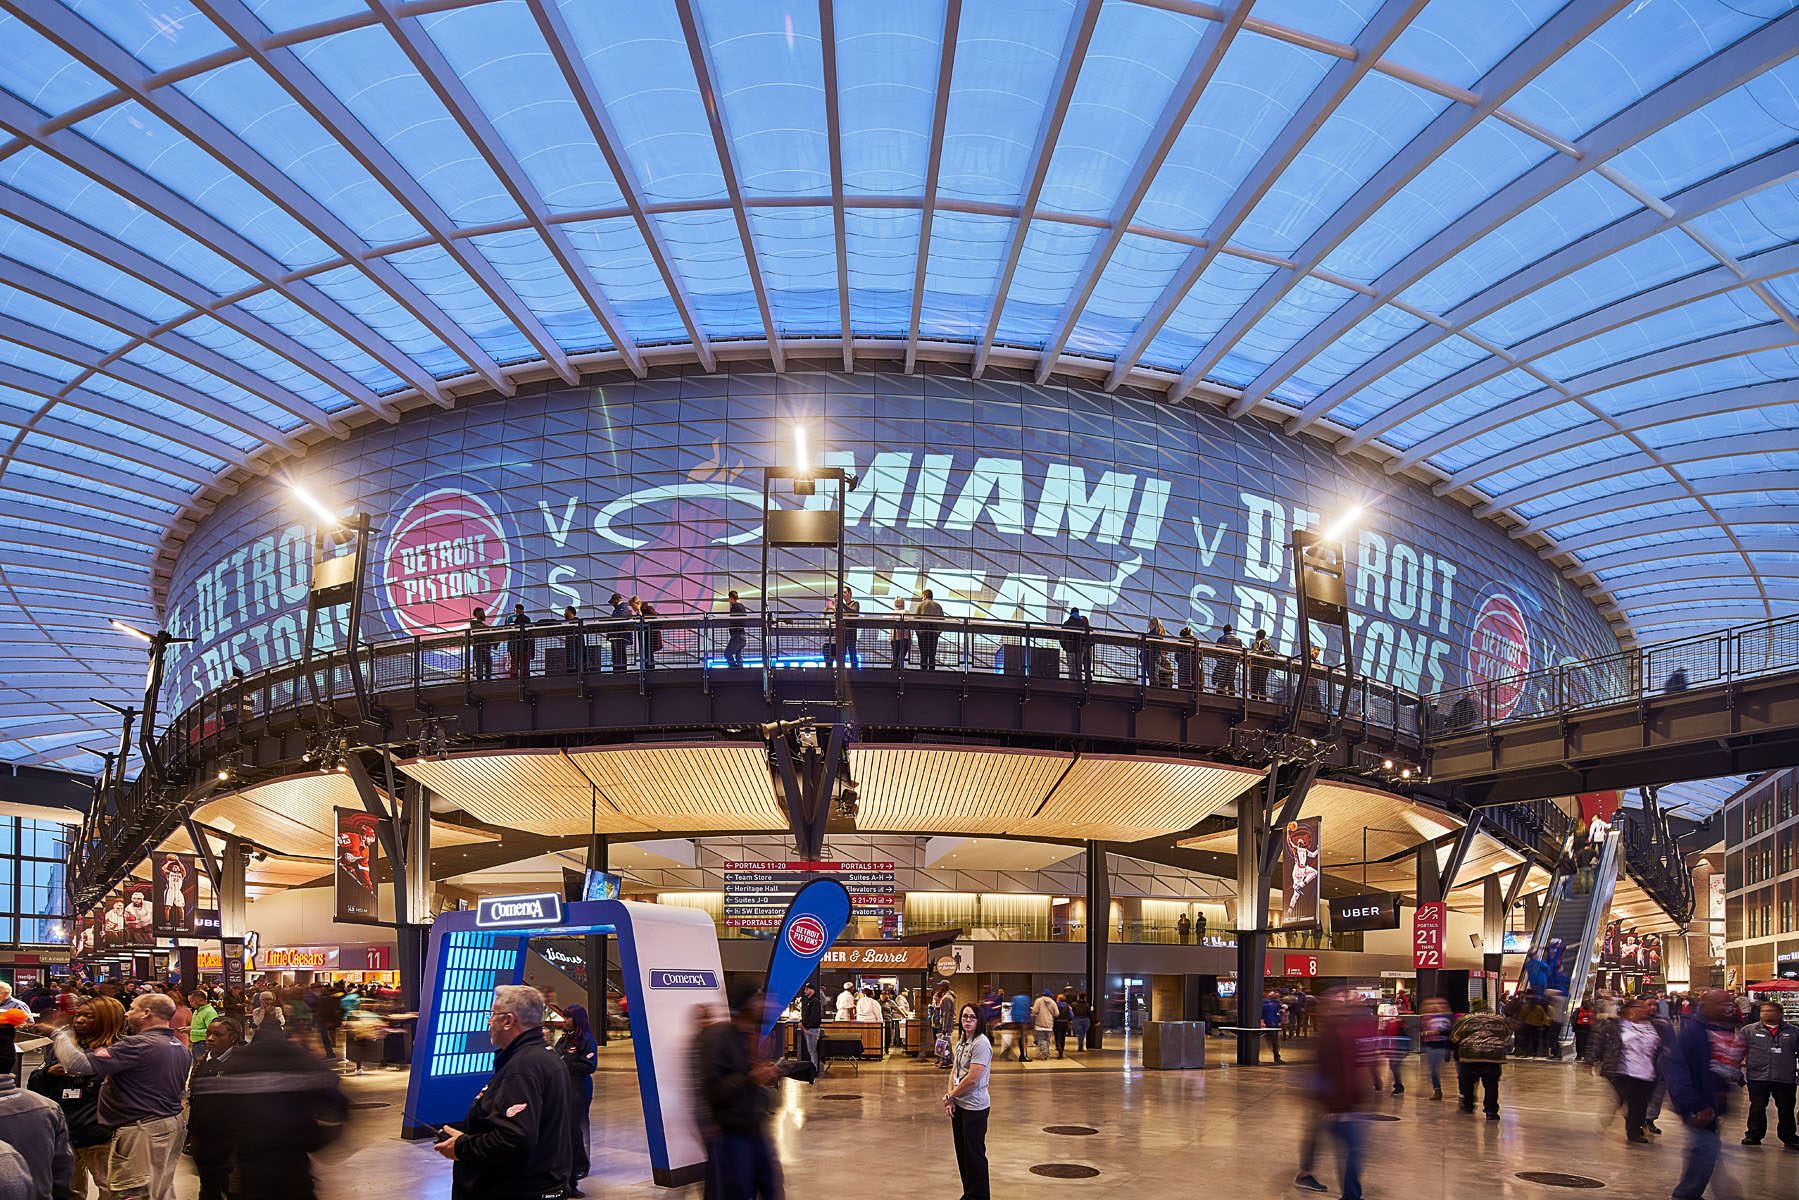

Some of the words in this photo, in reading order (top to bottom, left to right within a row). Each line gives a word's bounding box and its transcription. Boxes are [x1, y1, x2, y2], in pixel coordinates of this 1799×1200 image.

[792, 450, 1172, 550] MIAMI
[400, 534, 487, 576] DETROIT
[403, 567, 491, 607] PISTONS
[1482, 627, 1524, 666] DETROIT
[734, 885, 764, 893] Heritage
[1342, 906, 1380, 918] UBER
[194, 918, 220, 927] UBE
[794, 932, 818, 946] PISTONS
[796, 926, 820, 939] DETROIT
[1417, 930, 1437, 944] 21
[264, 950, 288, 967] Little
[287, 950, 325, 967] Caesars
[368, 952, 380, 968] 11
[850, 948, 861, 963] &
[862, 948, 908, 963] Barrel
[1417, 950, 1439, 965] 72
[1309, 960, 1317, 976] 8
